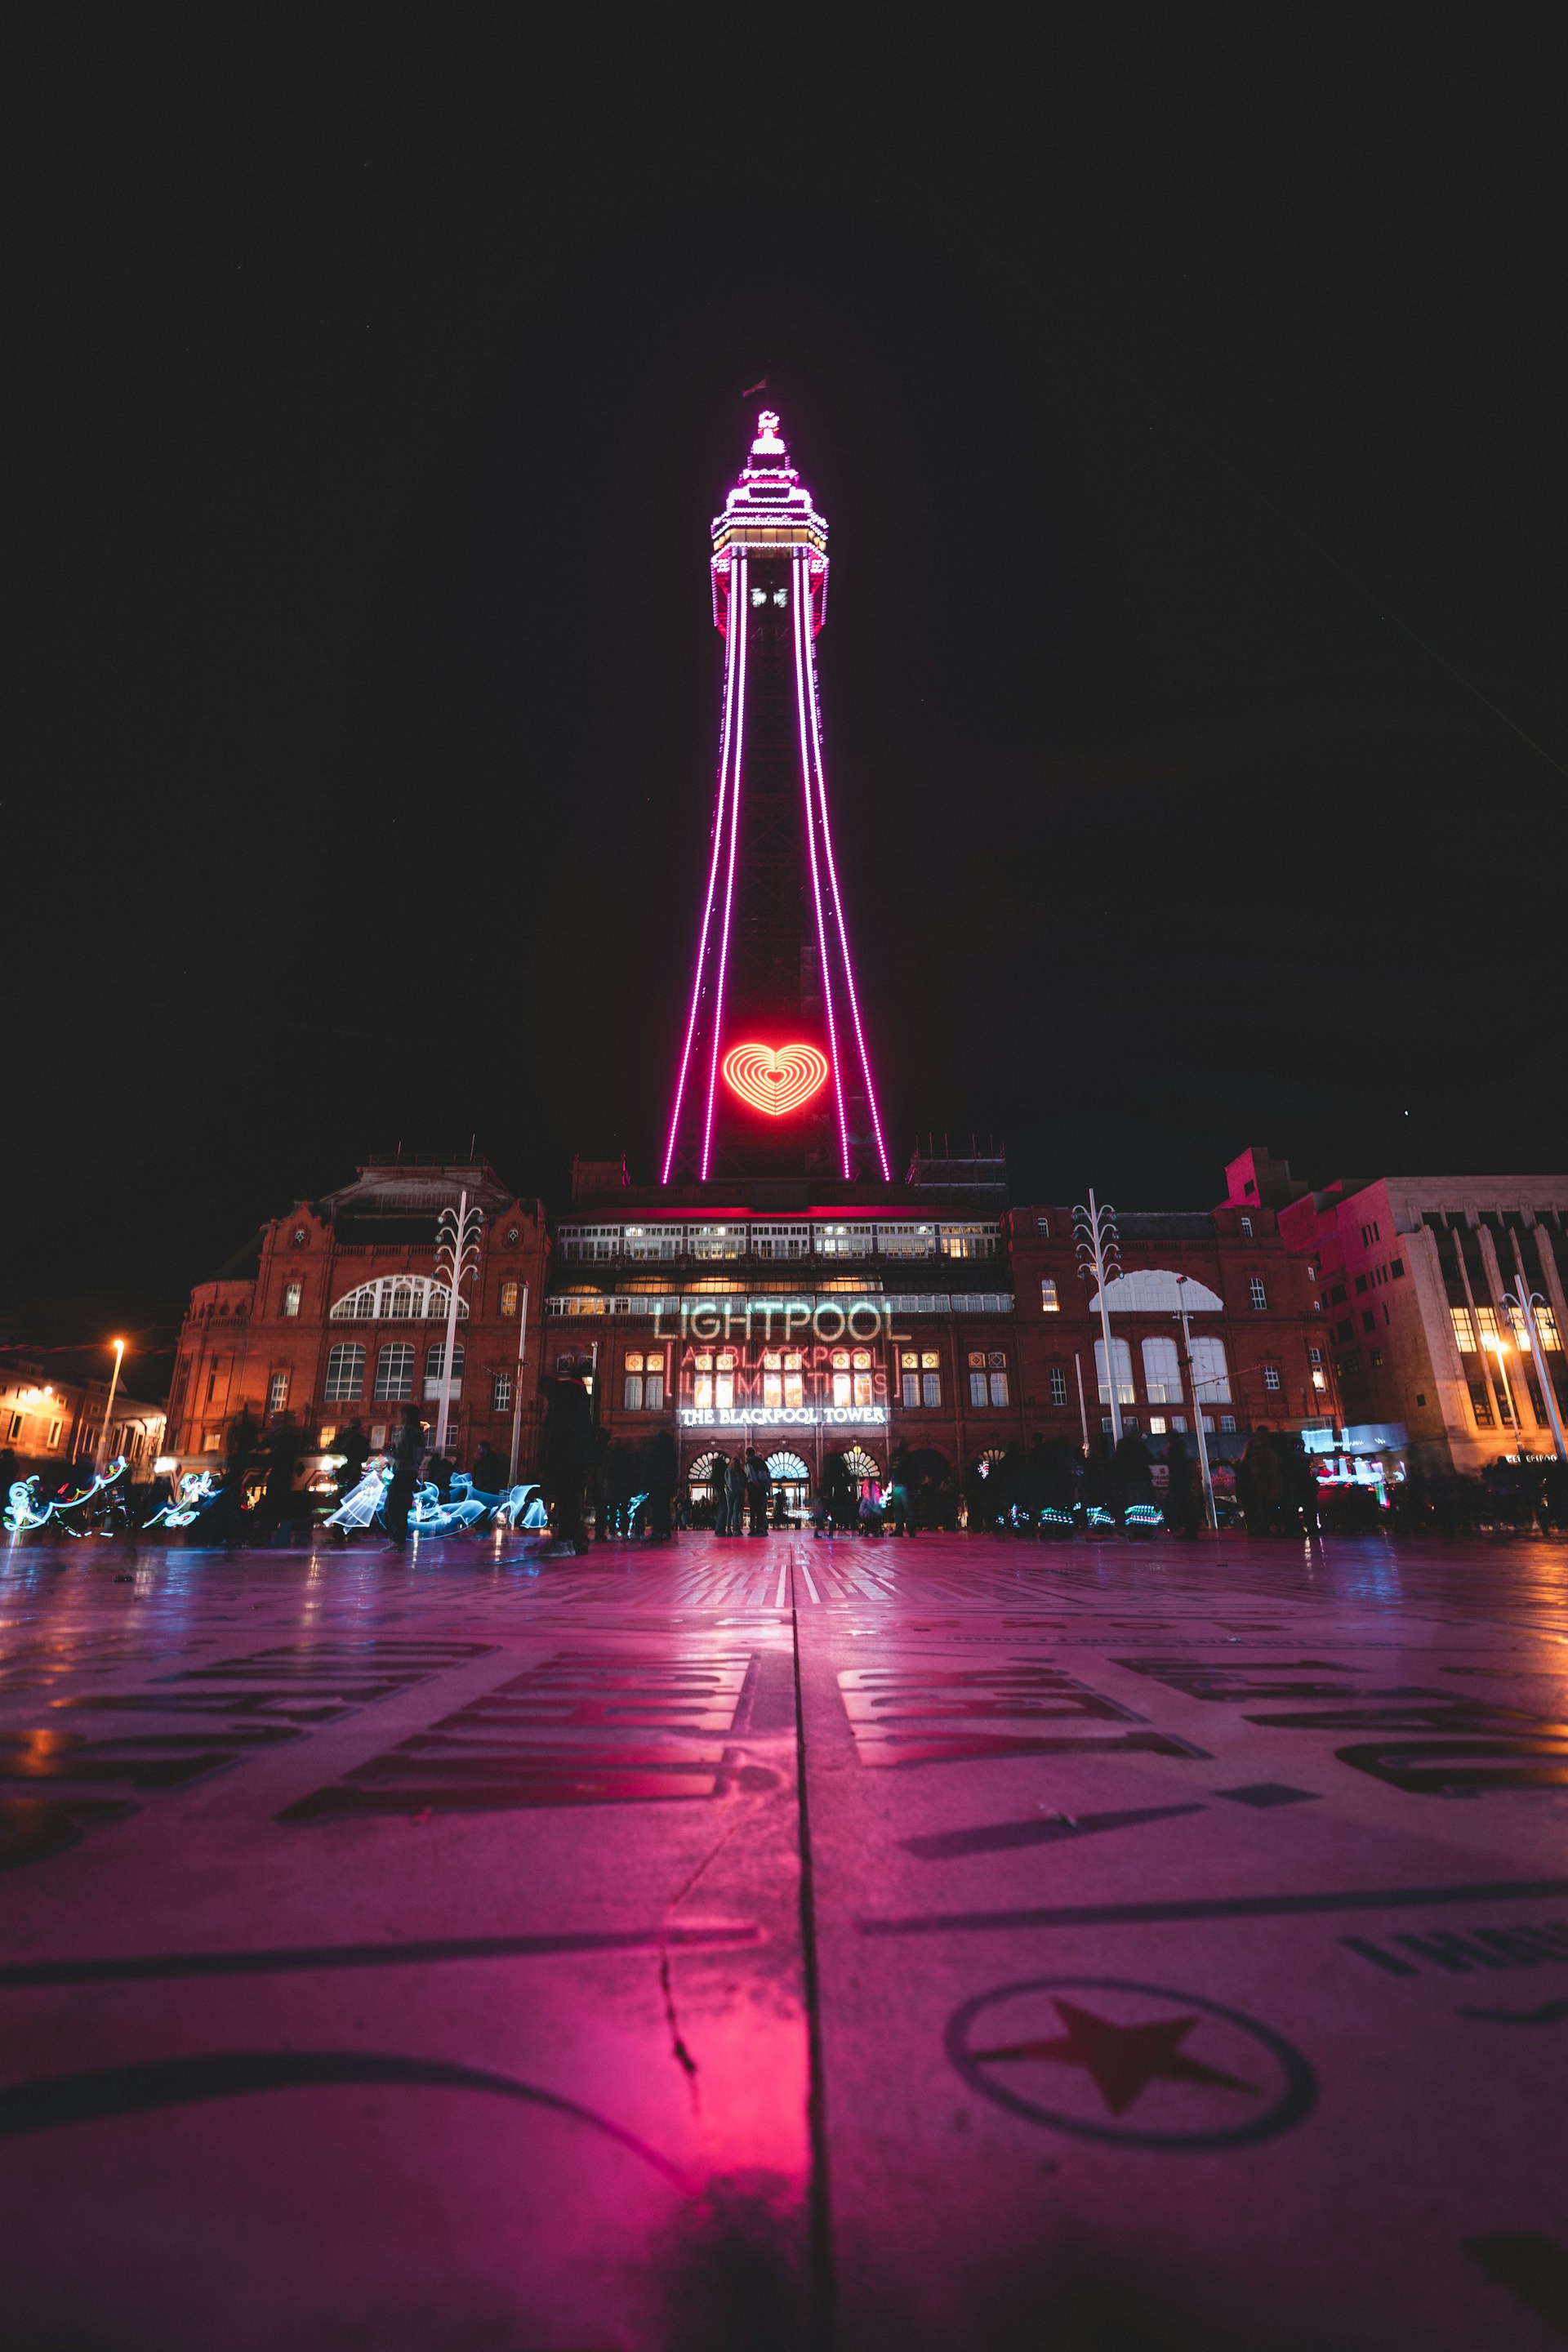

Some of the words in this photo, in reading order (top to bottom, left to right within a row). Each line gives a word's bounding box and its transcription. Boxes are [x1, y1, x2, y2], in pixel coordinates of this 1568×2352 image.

[653, 1302, 912, 1342] LIGHTPOOL
[681, 1409, 715, 1426] THE
[719, 1408, 817, 1425] BLACKPOOL
[823, 1407, 886, 1424] TOWER
